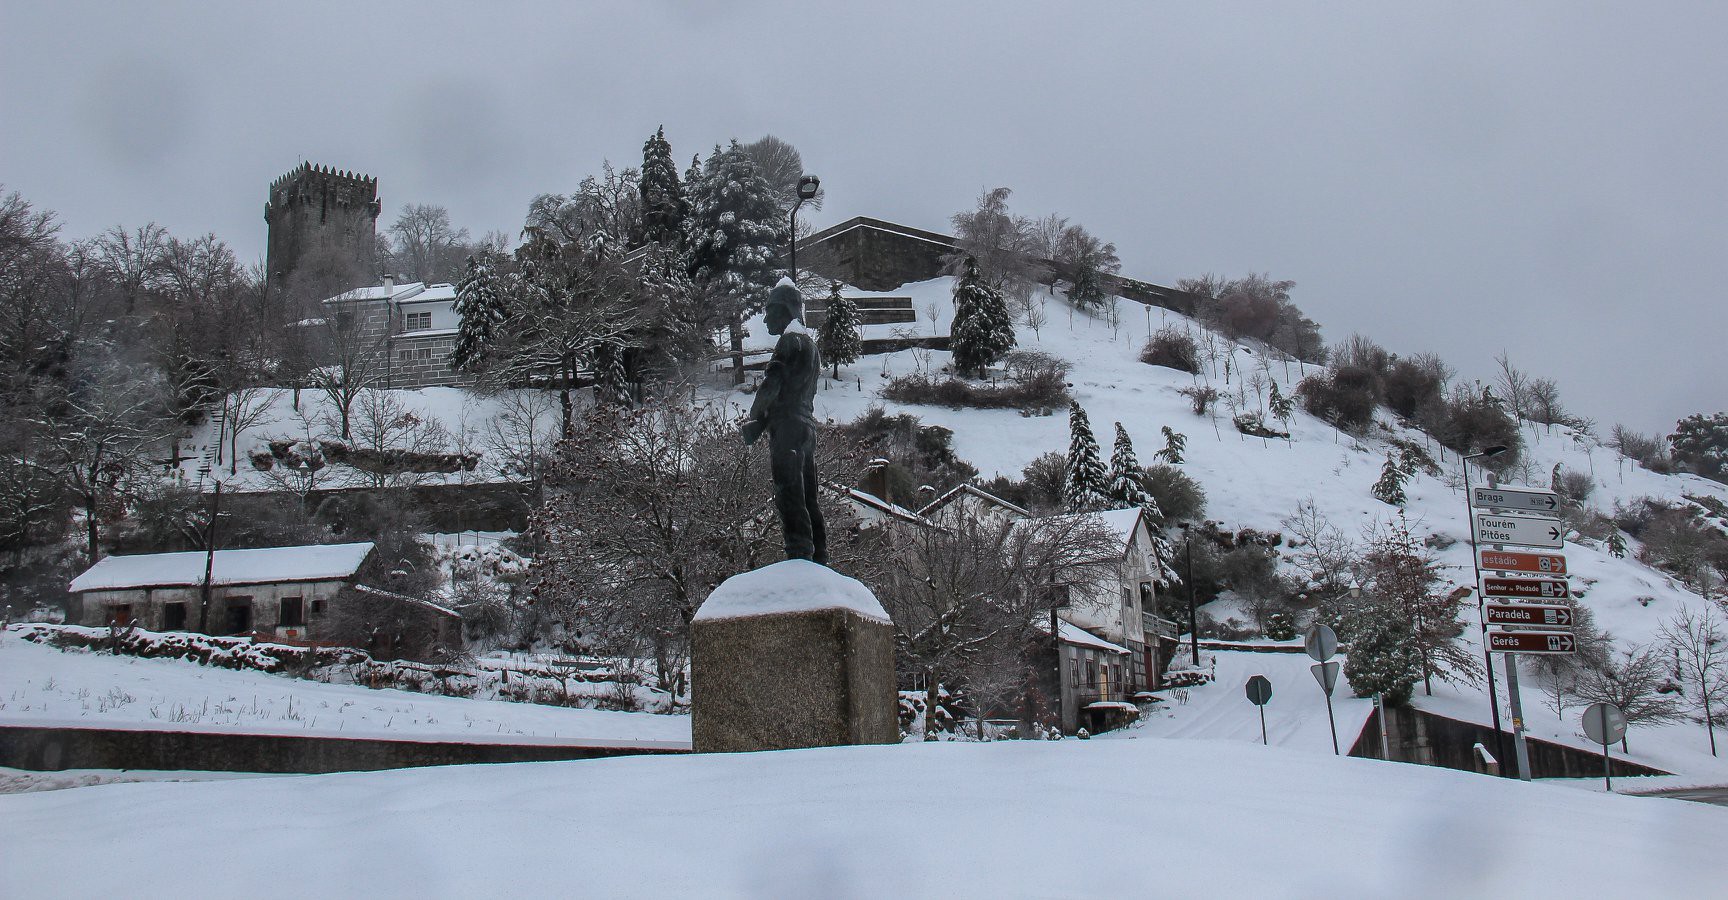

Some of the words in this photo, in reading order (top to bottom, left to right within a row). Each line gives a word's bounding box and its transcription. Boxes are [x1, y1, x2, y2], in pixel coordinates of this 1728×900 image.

[1477, 492, 1503, 503] Braga
[1480, 518, 1516, 529] Tourém
[1481, 530, 1510, 540] Pitões
[1483, 556, 1518, 566] estádio
[1515, 584, 1539, 592] Piedade
[1489, 608, 1531, 619] Paradela
[1492, 637, 1520, 646] Gerês
